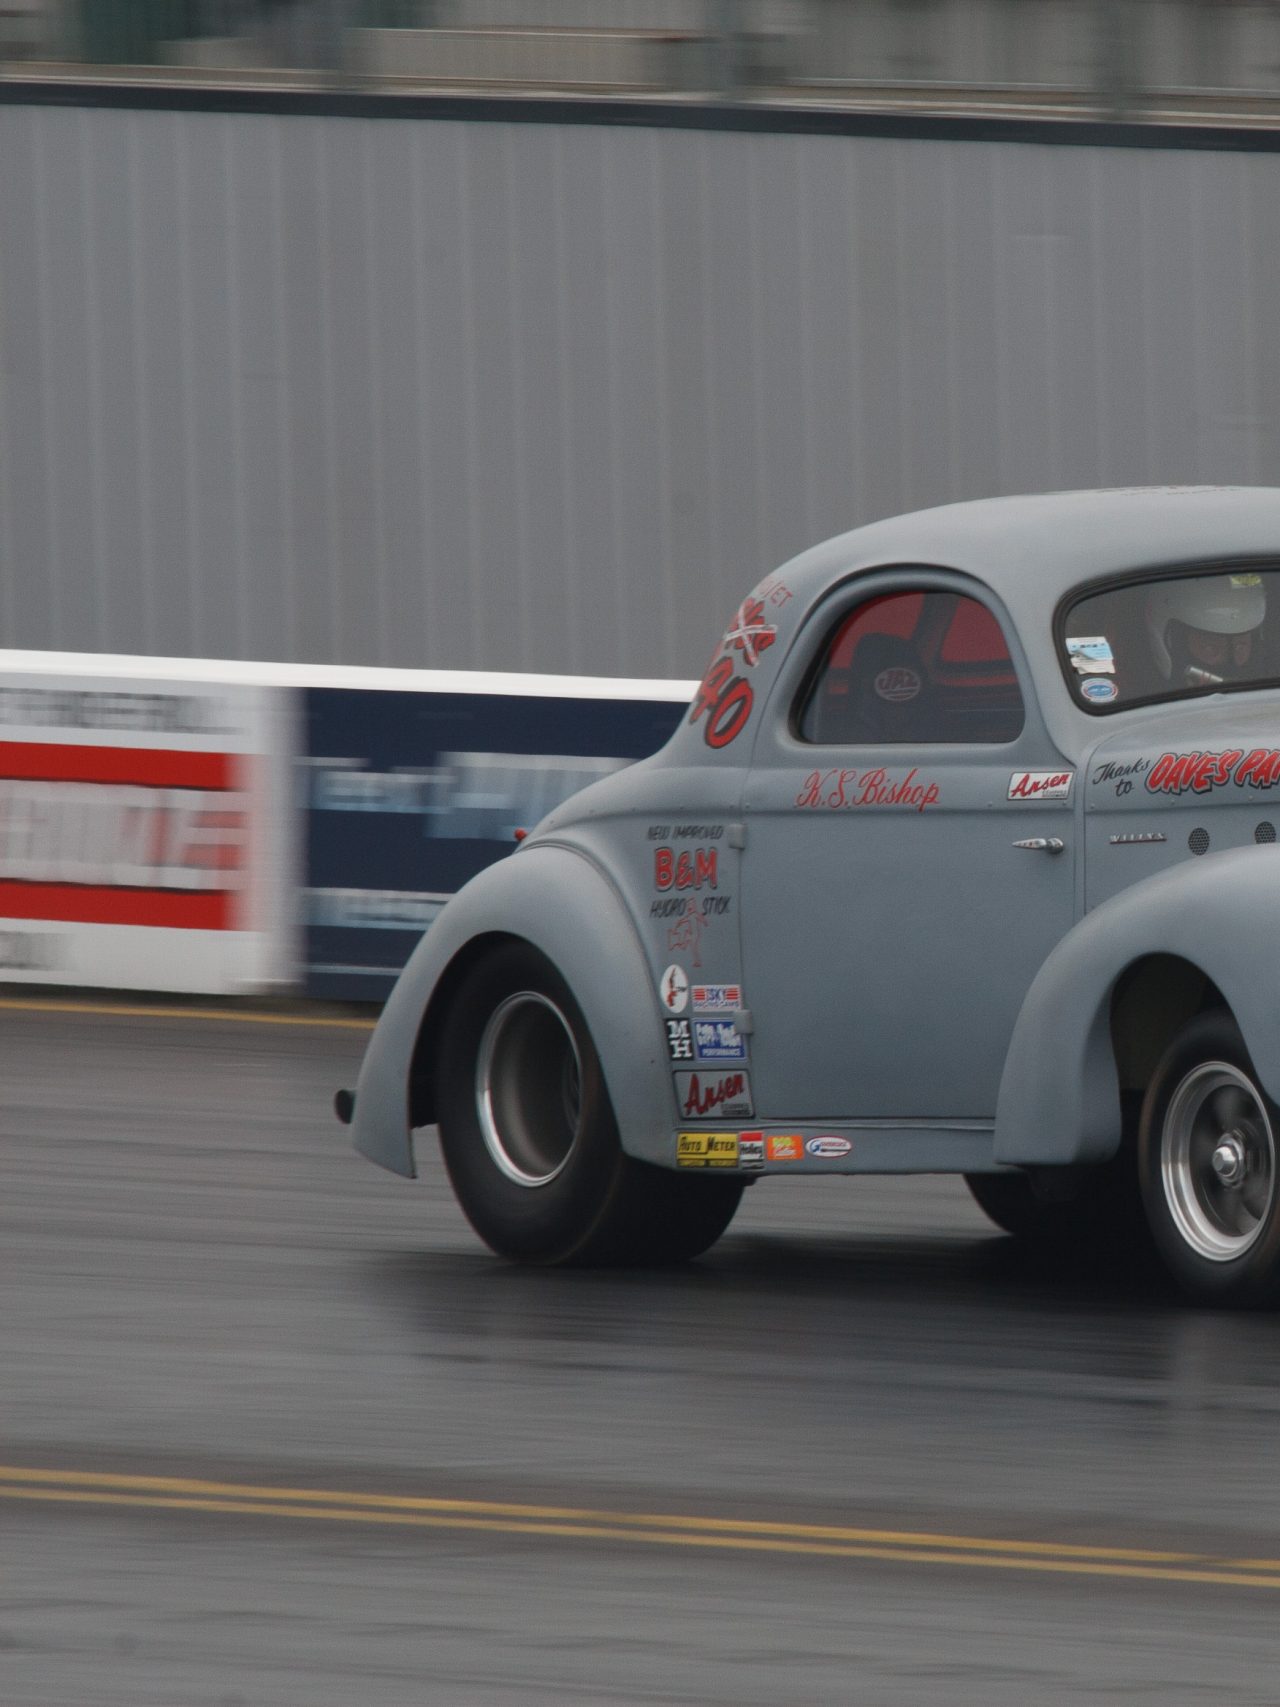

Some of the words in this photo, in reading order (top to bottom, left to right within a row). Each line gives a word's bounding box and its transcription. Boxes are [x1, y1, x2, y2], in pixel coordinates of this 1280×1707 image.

[1092, 757, 1150, 785] Thanks
[1011, 773, 1070, 797] Ansen
[1115, 780, 1134, 797] to
[1110, 832, 1165, 843] WILLYS
[654, 846, 719, 893] B&M
[683, 1073, 745, 1117] Ansen
